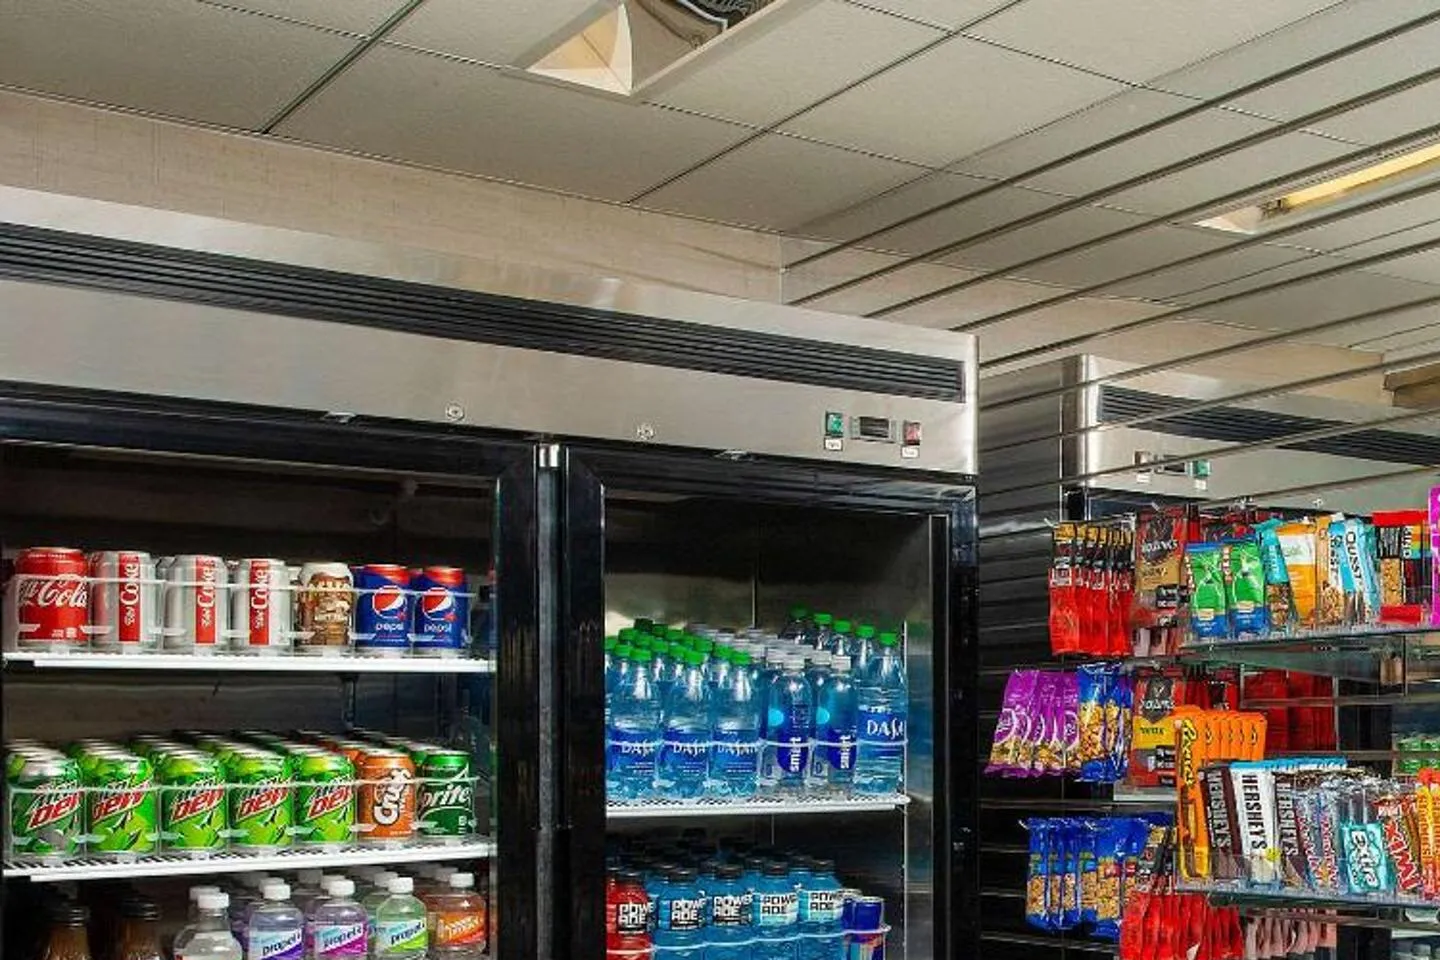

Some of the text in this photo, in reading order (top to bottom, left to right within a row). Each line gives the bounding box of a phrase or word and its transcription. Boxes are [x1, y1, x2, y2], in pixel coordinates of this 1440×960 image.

[120, 562, 139, 606] Coke
[375, 621, 404, 633] pepsi
[423, 622, 453, 634] pepsi
[1241, 773, 1268, 850] HERSHEY'S
[1275, 774, 1299, 857] HERSHEY'S
